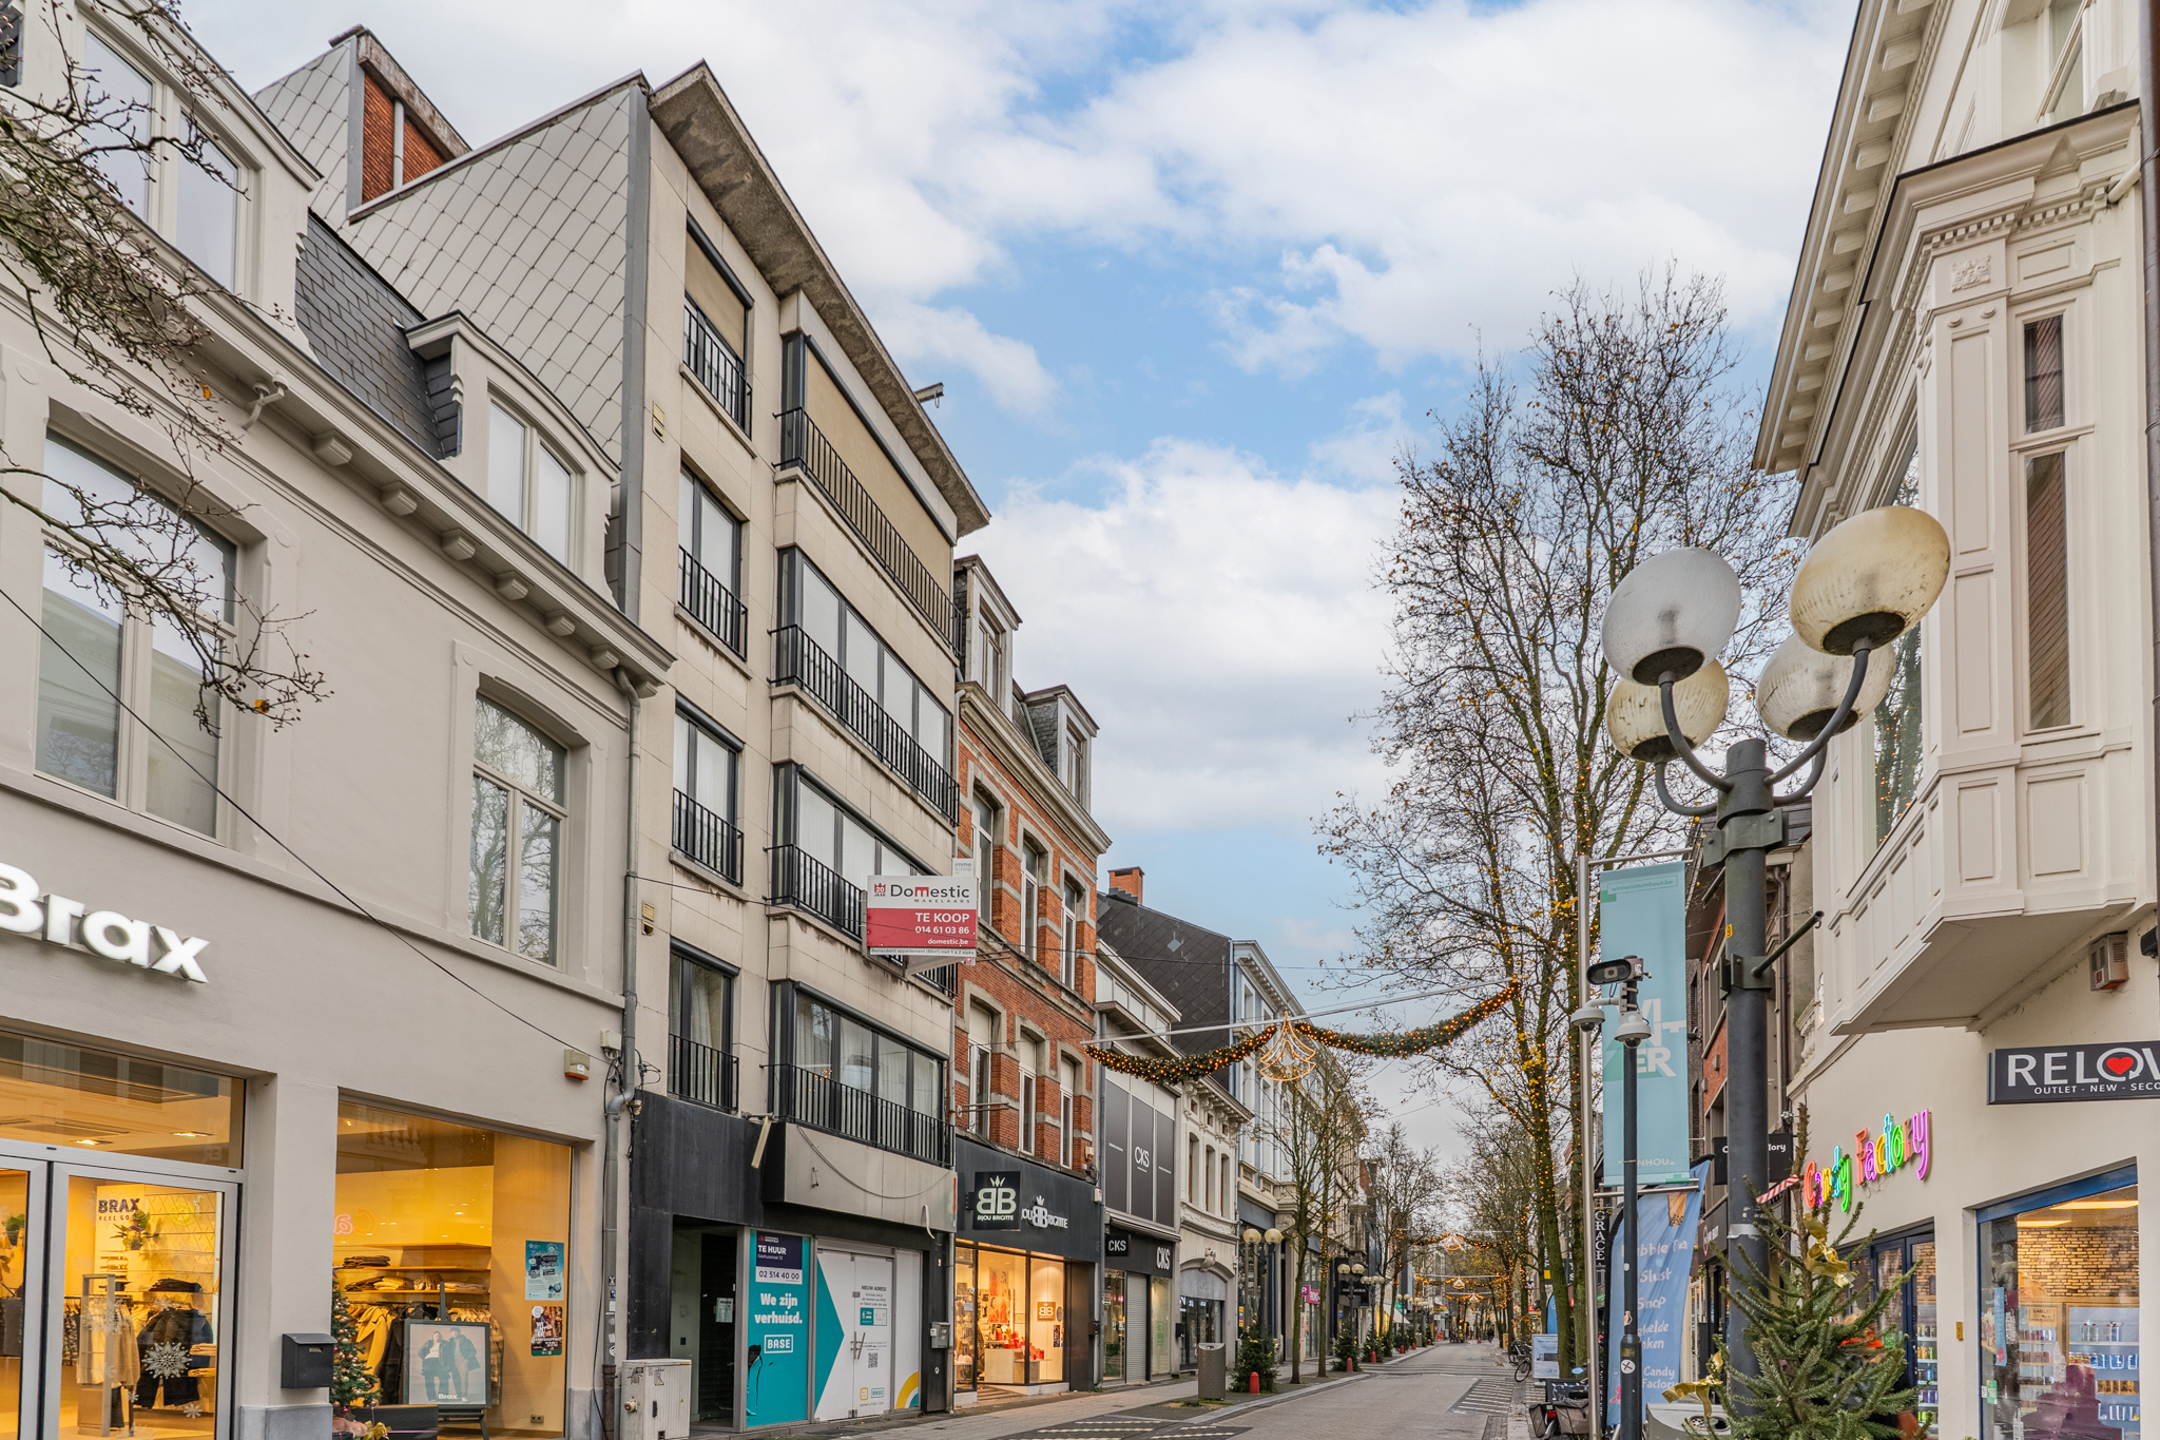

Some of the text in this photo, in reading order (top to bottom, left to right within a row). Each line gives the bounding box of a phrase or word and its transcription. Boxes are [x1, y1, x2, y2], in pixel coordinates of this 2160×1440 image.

[890, 884, 970, 898] Domestic
[1611, 880, 1674, 893] winterinturnhout.be
[0, 862, 210, 983] Brax
[915, 913, 970, 923] TE KOOP
[915, 926, 970, 935] 014 61 03 86
[927, 938, 969, 946] domestic.be
[2034, 1086, 2077, 1095] OUTLET
[2090, 1084, 2117, 1092] NEW
[2130, 1081, 2160, 1091] SECO
[1855, 1108, 1930, 1186] Factory
[1134, 1146, 1150, 1168] CKS
[1803, 1145, 1850, 1213] Candy
[98, 1198, 140, 1214] BRAX
[1595, 1211, 1606, 1261] GRACE
[758, 1245, 787, 1255] TE HUUR
[1108, 1240, 1127, 1252] CKS
[1621, 1243, 1669, 1257] bble
[1156, 1246, 1171, 1270] CKS
[759, 1270, 767, 1278] 02
[769, 1271, 779, 1279] 514
[760, 1293, 798, 1310] We zijn
[754, 1311, 803, 1324] verhuisd.
[767, 1339, 791, 1349] BASE
[1643, 1366, 1675, 1380] Candy
